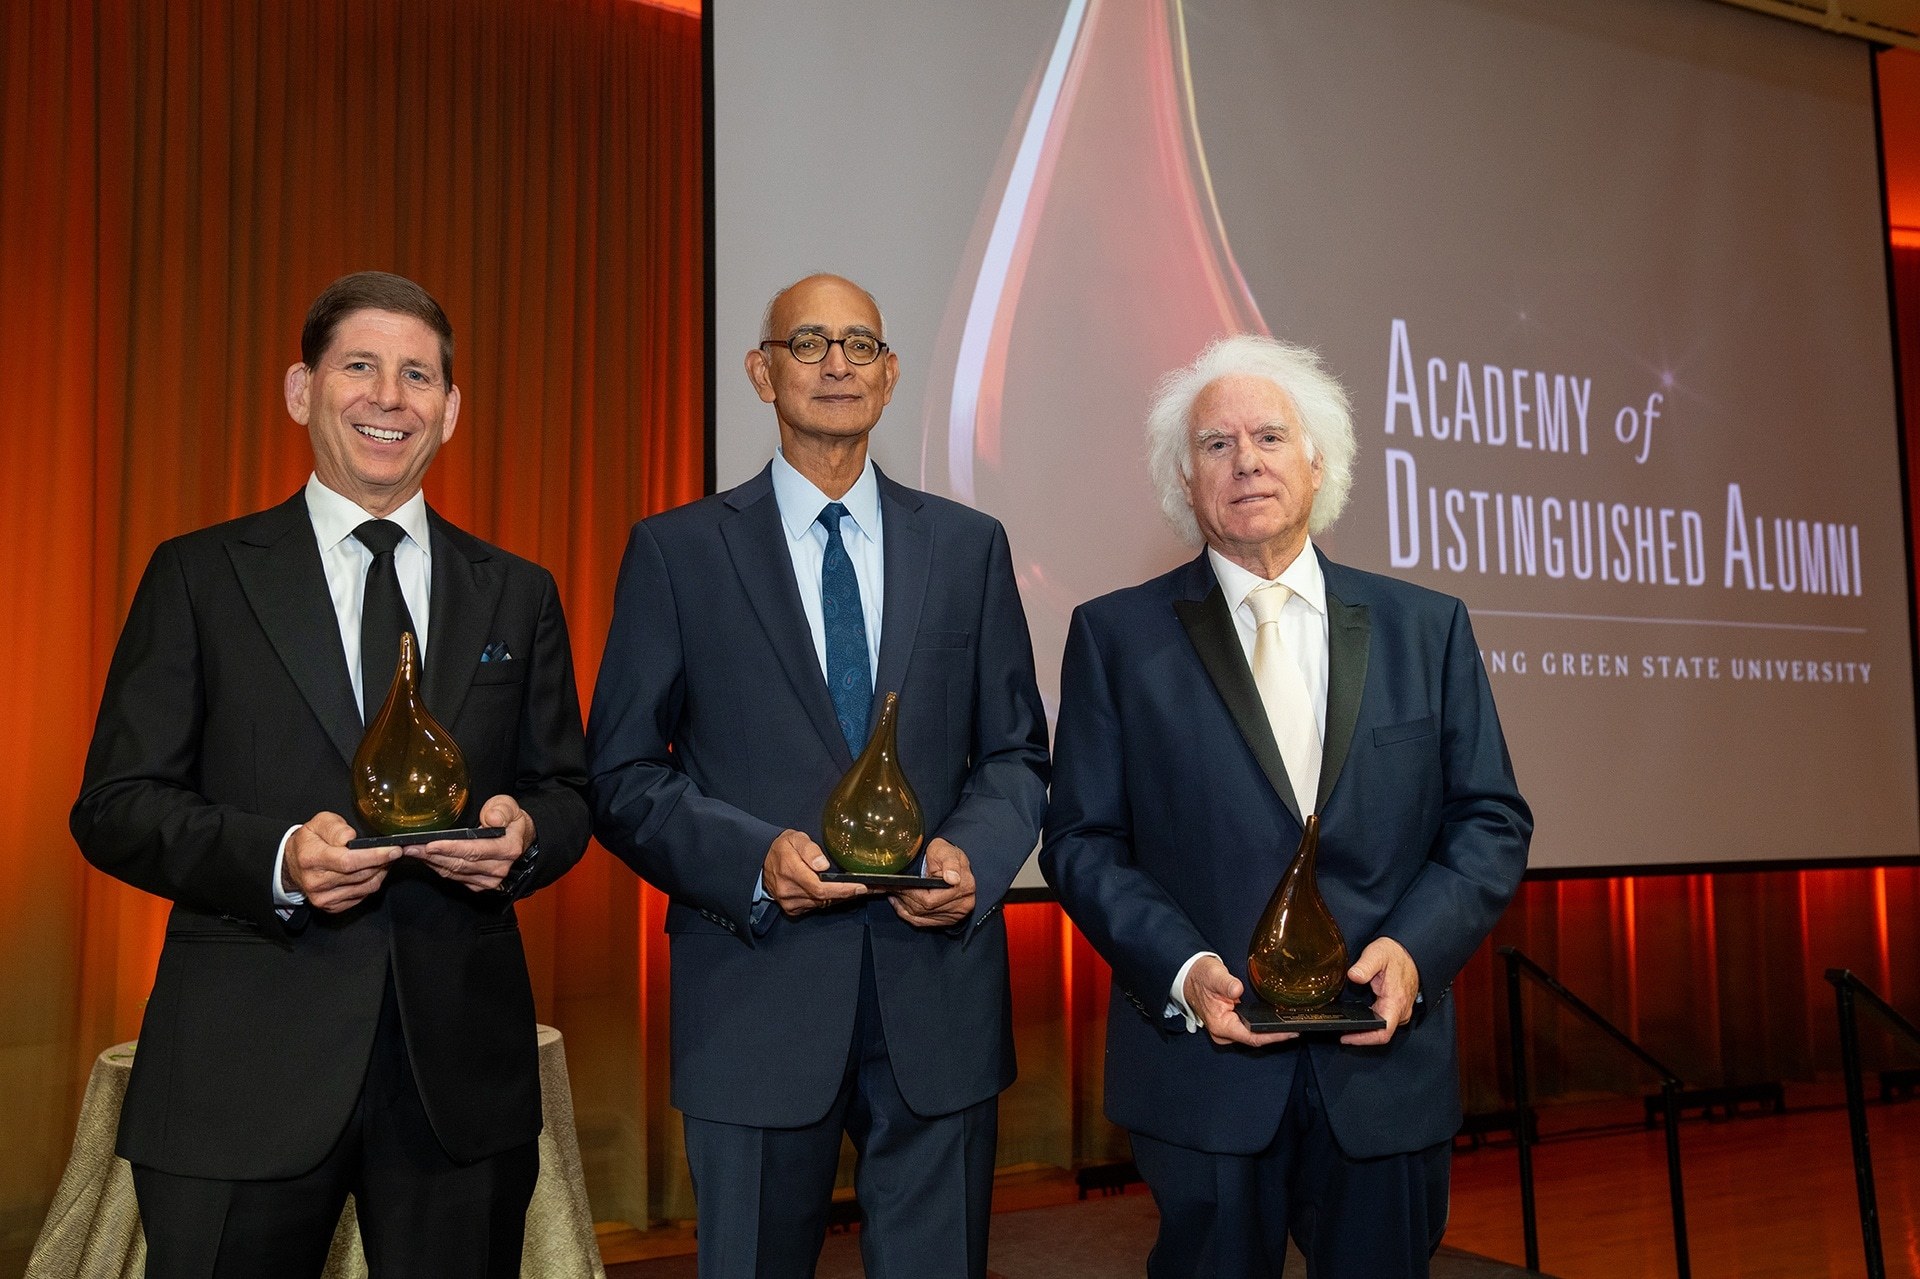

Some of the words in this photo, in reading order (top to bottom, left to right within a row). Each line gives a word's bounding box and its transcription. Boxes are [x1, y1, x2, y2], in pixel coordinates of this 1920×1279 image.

[1384, 318, 1591, 455] ACADEMY
[1614, 392, 1663, 464] of
[1384, 448, 1706, 587] DISTINGUISHED
[1724, 483, 1863, 597] ALUMNI
[1542, 652, 1629, 677] GREEN
[1642, 656, 1720, 680] STATE
[1731, 659, 1872, 684] UNIVERSITY
